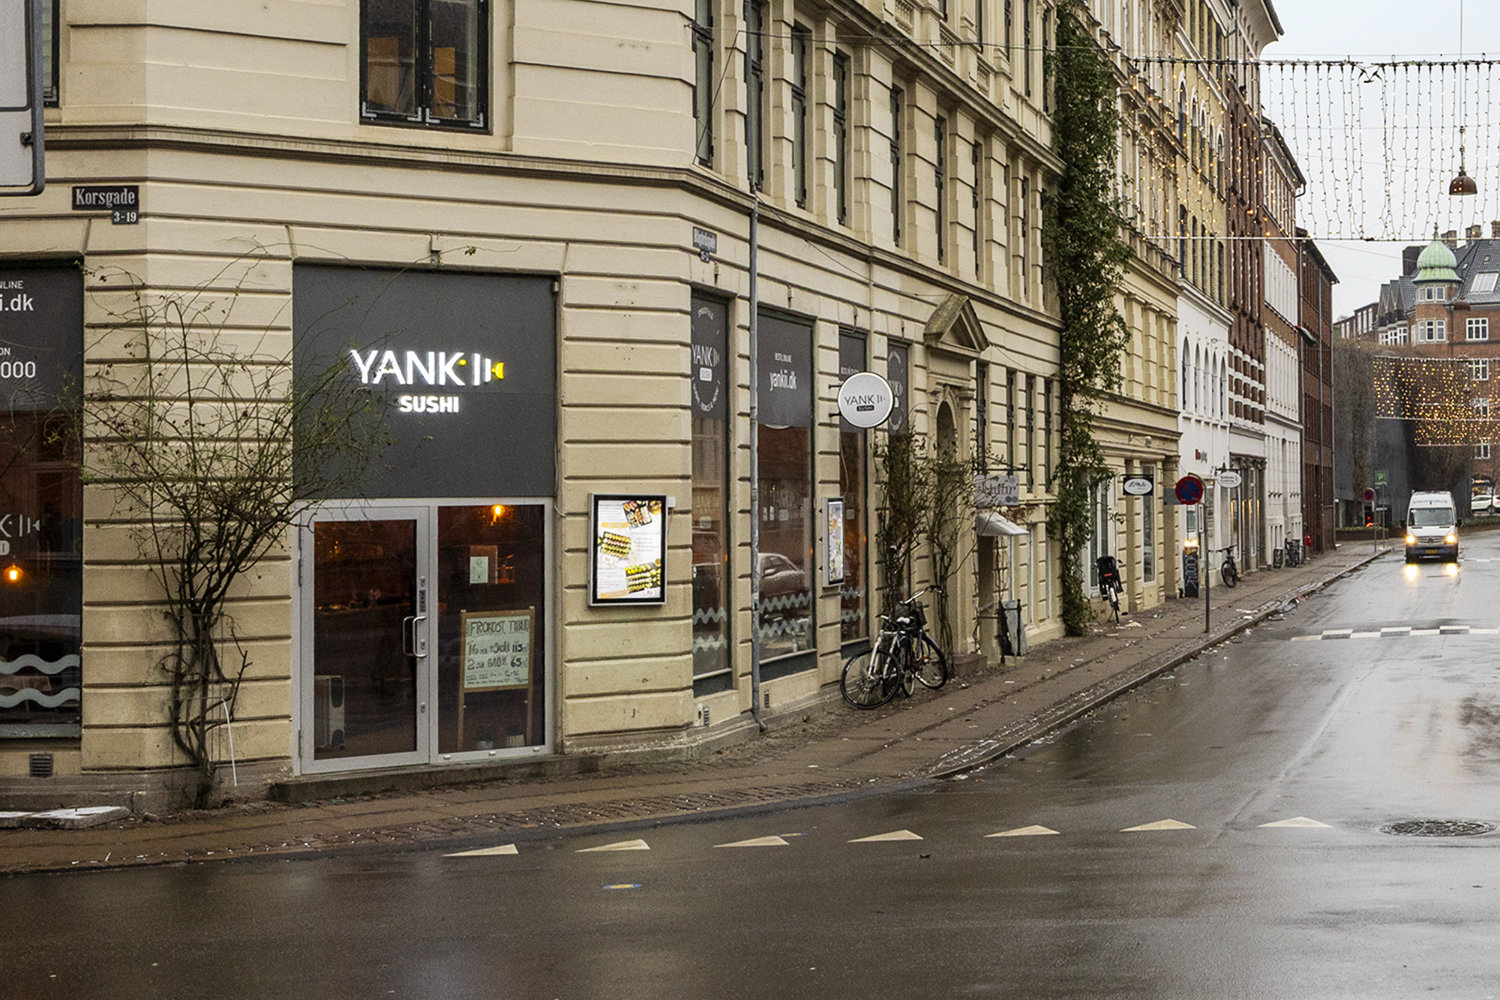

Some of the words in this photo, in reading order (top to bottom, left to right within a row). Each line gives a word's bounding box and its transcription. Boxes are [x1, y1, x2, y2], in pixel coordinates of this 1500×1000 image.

[75, 187, 136, 208] Korsgade
[113, 212, 137, 223] 3-19
[399, 395, 460, 413] SUSHI
